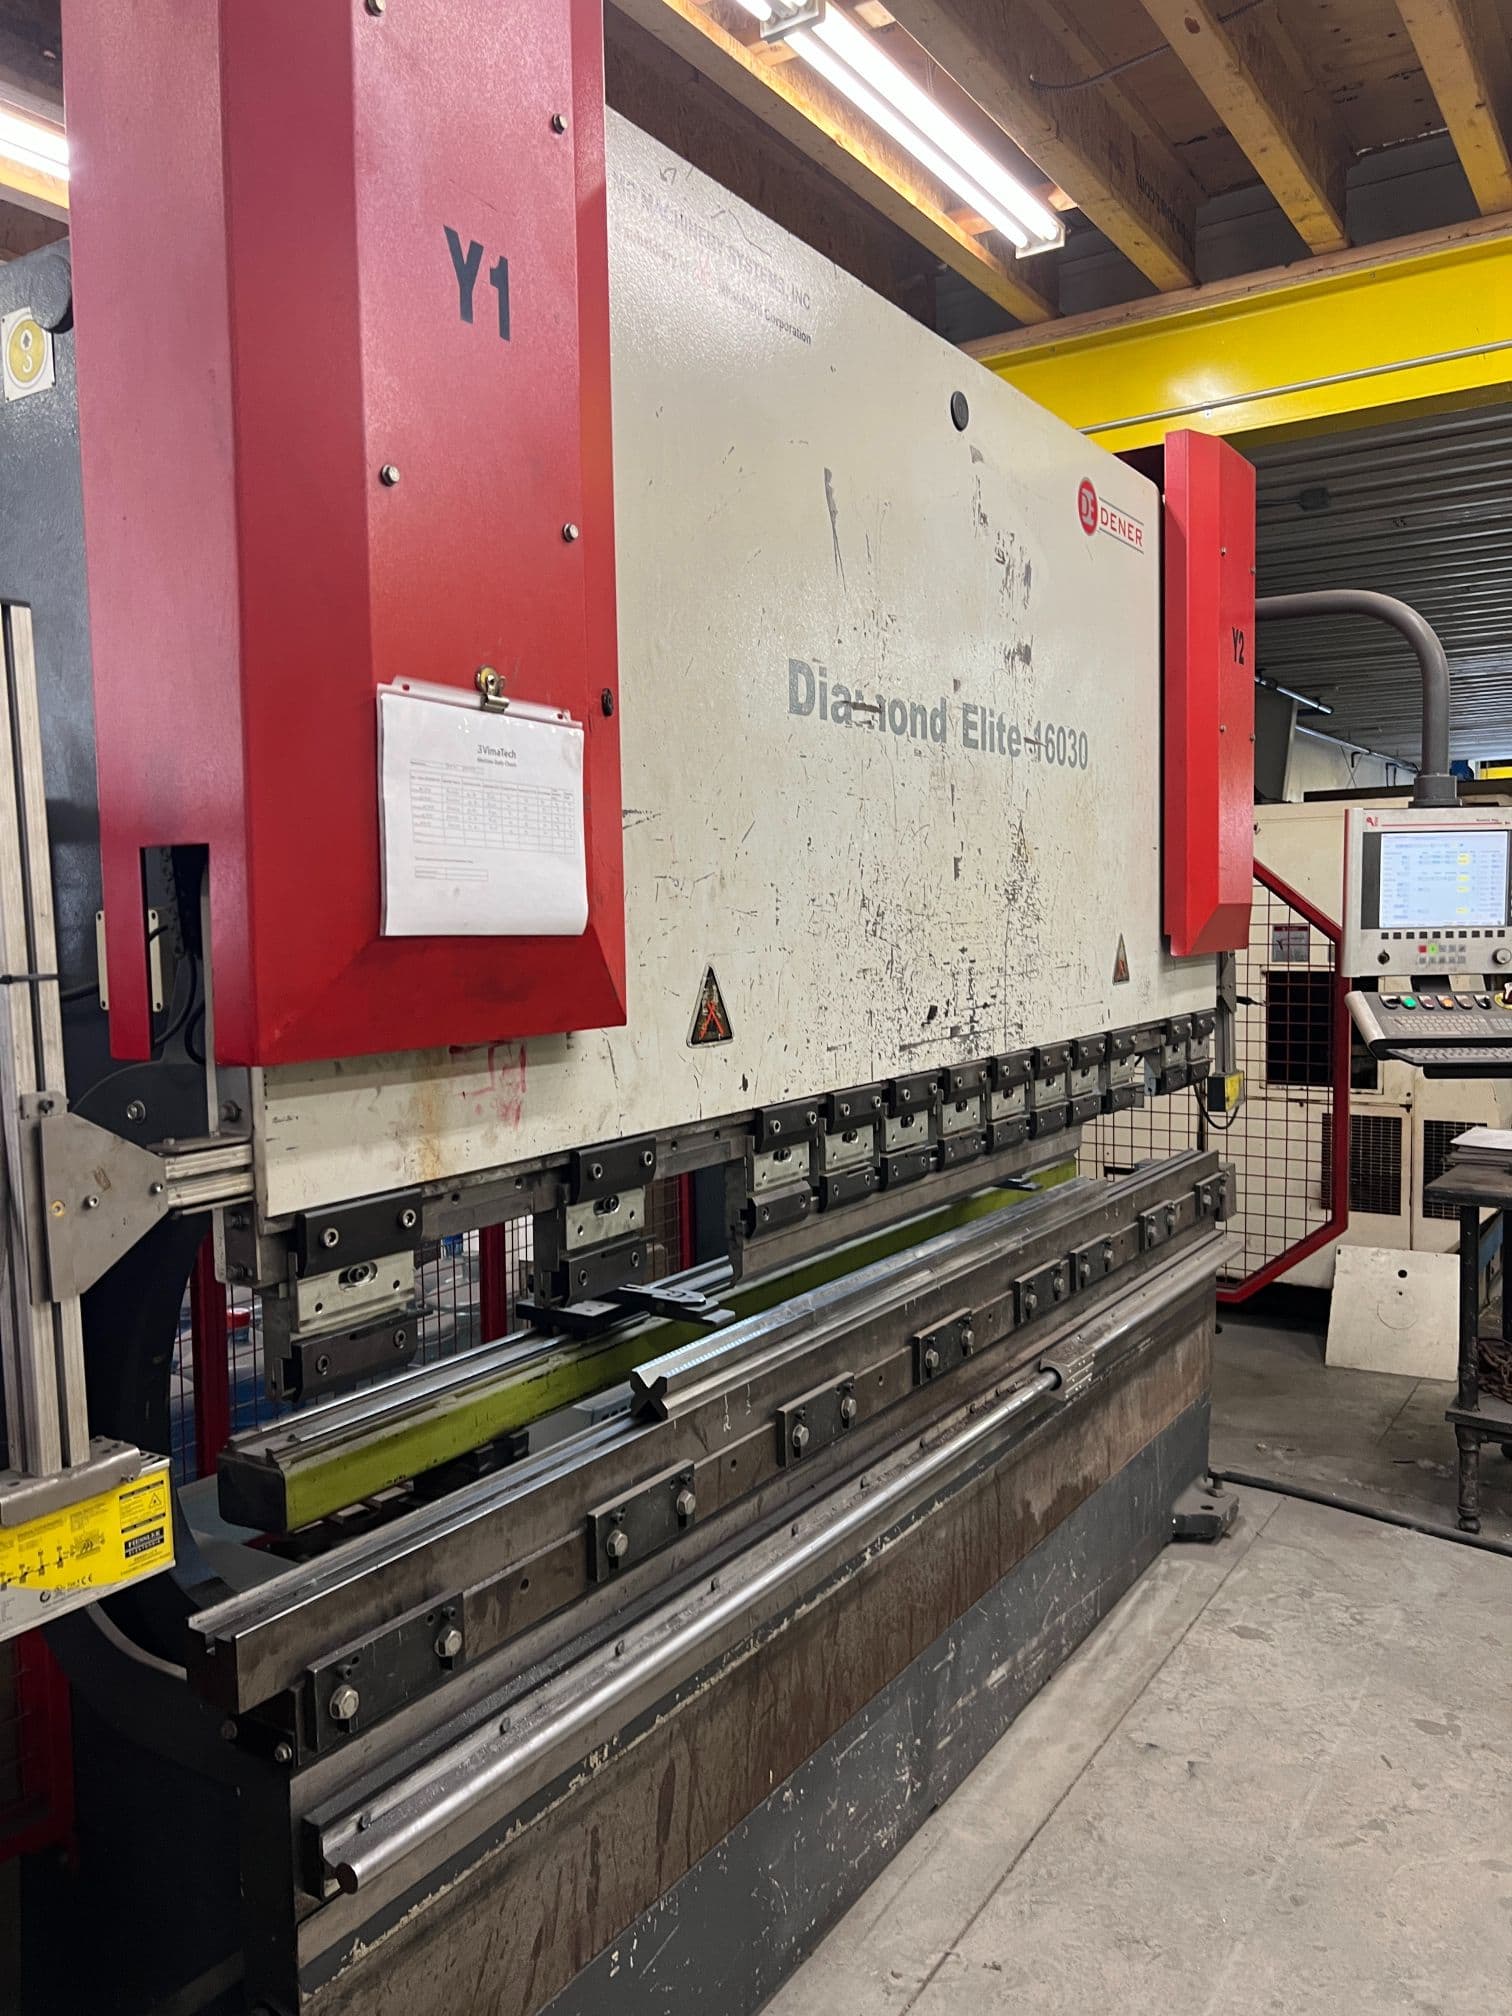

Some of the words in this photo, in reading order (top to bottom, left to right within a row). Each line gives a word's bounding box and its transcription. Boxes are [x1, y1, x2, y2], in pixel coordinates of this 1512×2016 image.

[443, 224, 510, 341] Y1
[791, 284, 811, 311] INC
[763, 307, 811, 345] Corporation
[1101, 507, 1142, 546] DENER
[1232, 627, 1244, 665] Y2
[963, 703, 1021, 757] Elite
[1034, 721, 1088, 769] 16030
